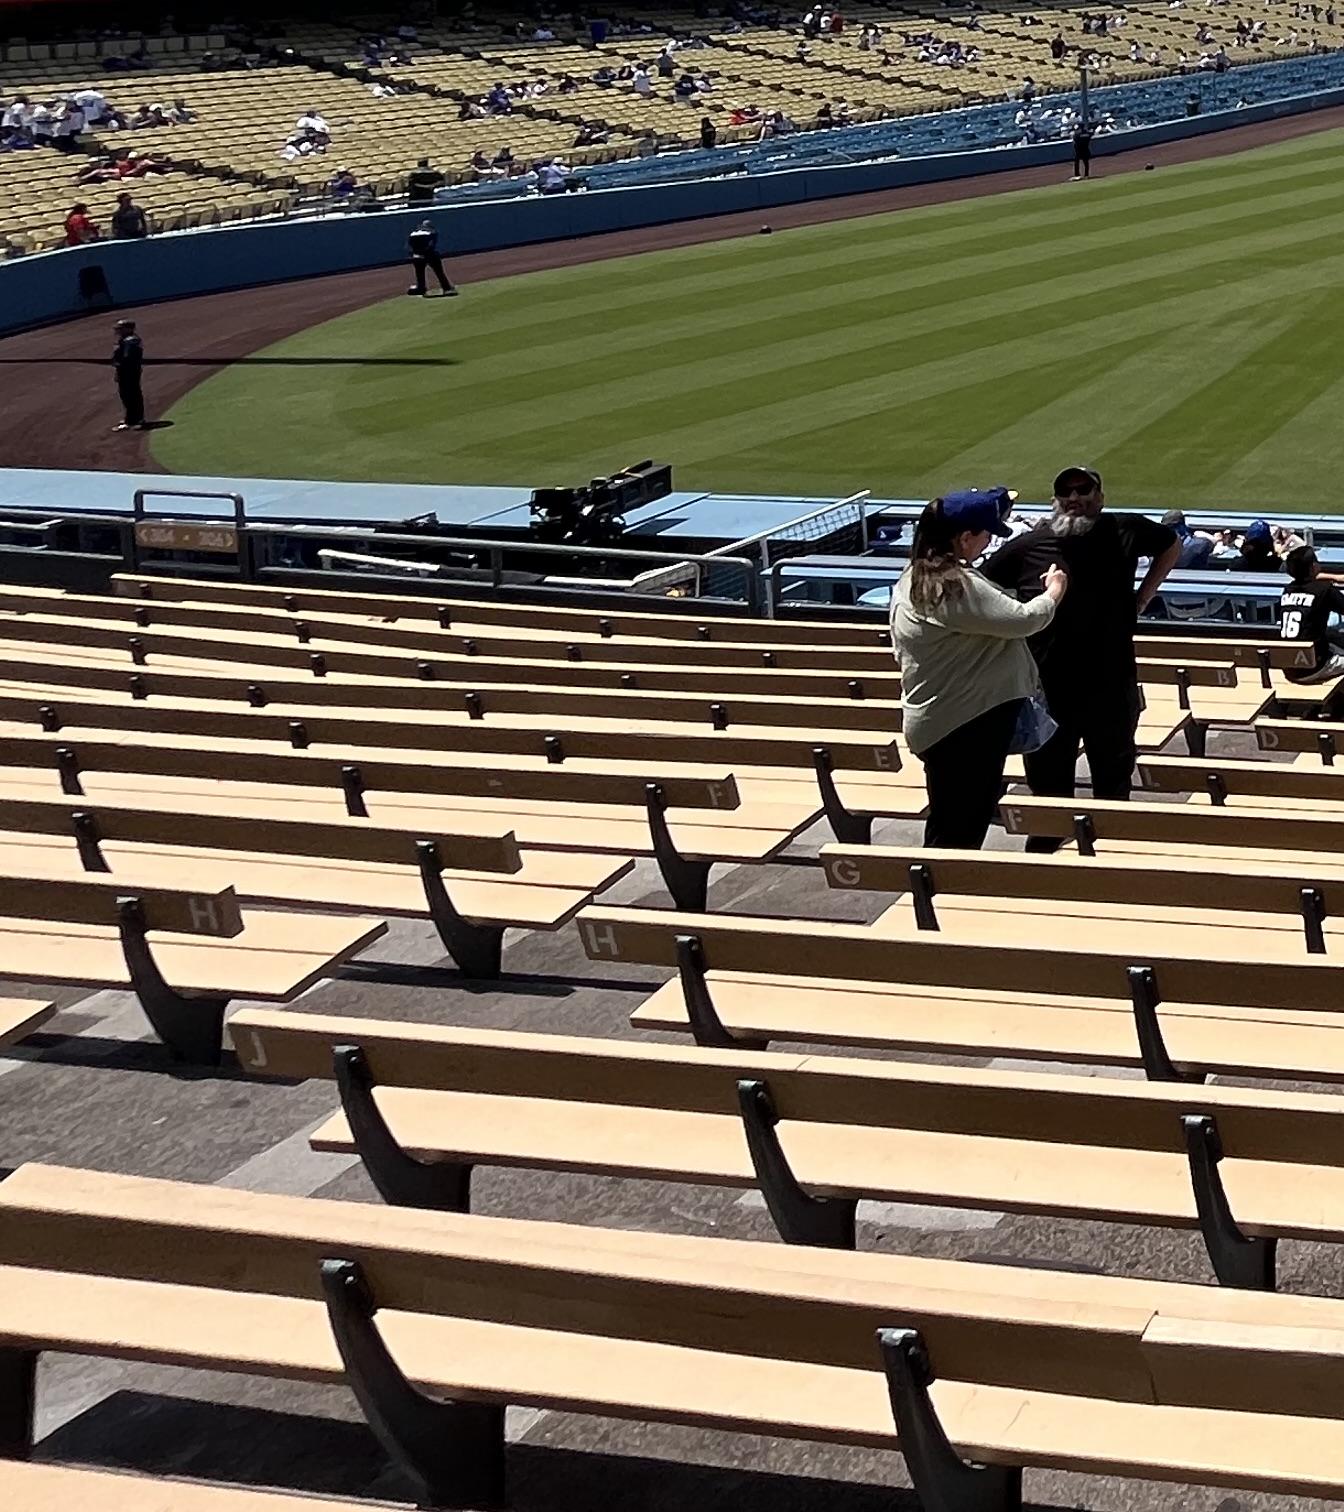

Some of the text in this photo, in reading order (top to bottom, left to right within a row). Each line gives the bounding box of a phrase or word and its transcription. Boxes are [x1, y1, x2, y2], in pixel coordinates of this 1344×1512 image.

[1294, 652, 1309, 666] A
[1216, 671, 1230, 686] B
[1261, 730, 1279, 748] D
[874, 748, 891, 768] E
[708, 783, 722, 806] F
[1005, 808, 1023, 831] F
[831, 859, 861, 885] G
[189, 897, 219, 930] H
[587, 923, 619, 956] H
[249, 1031, 267, 1068] J
